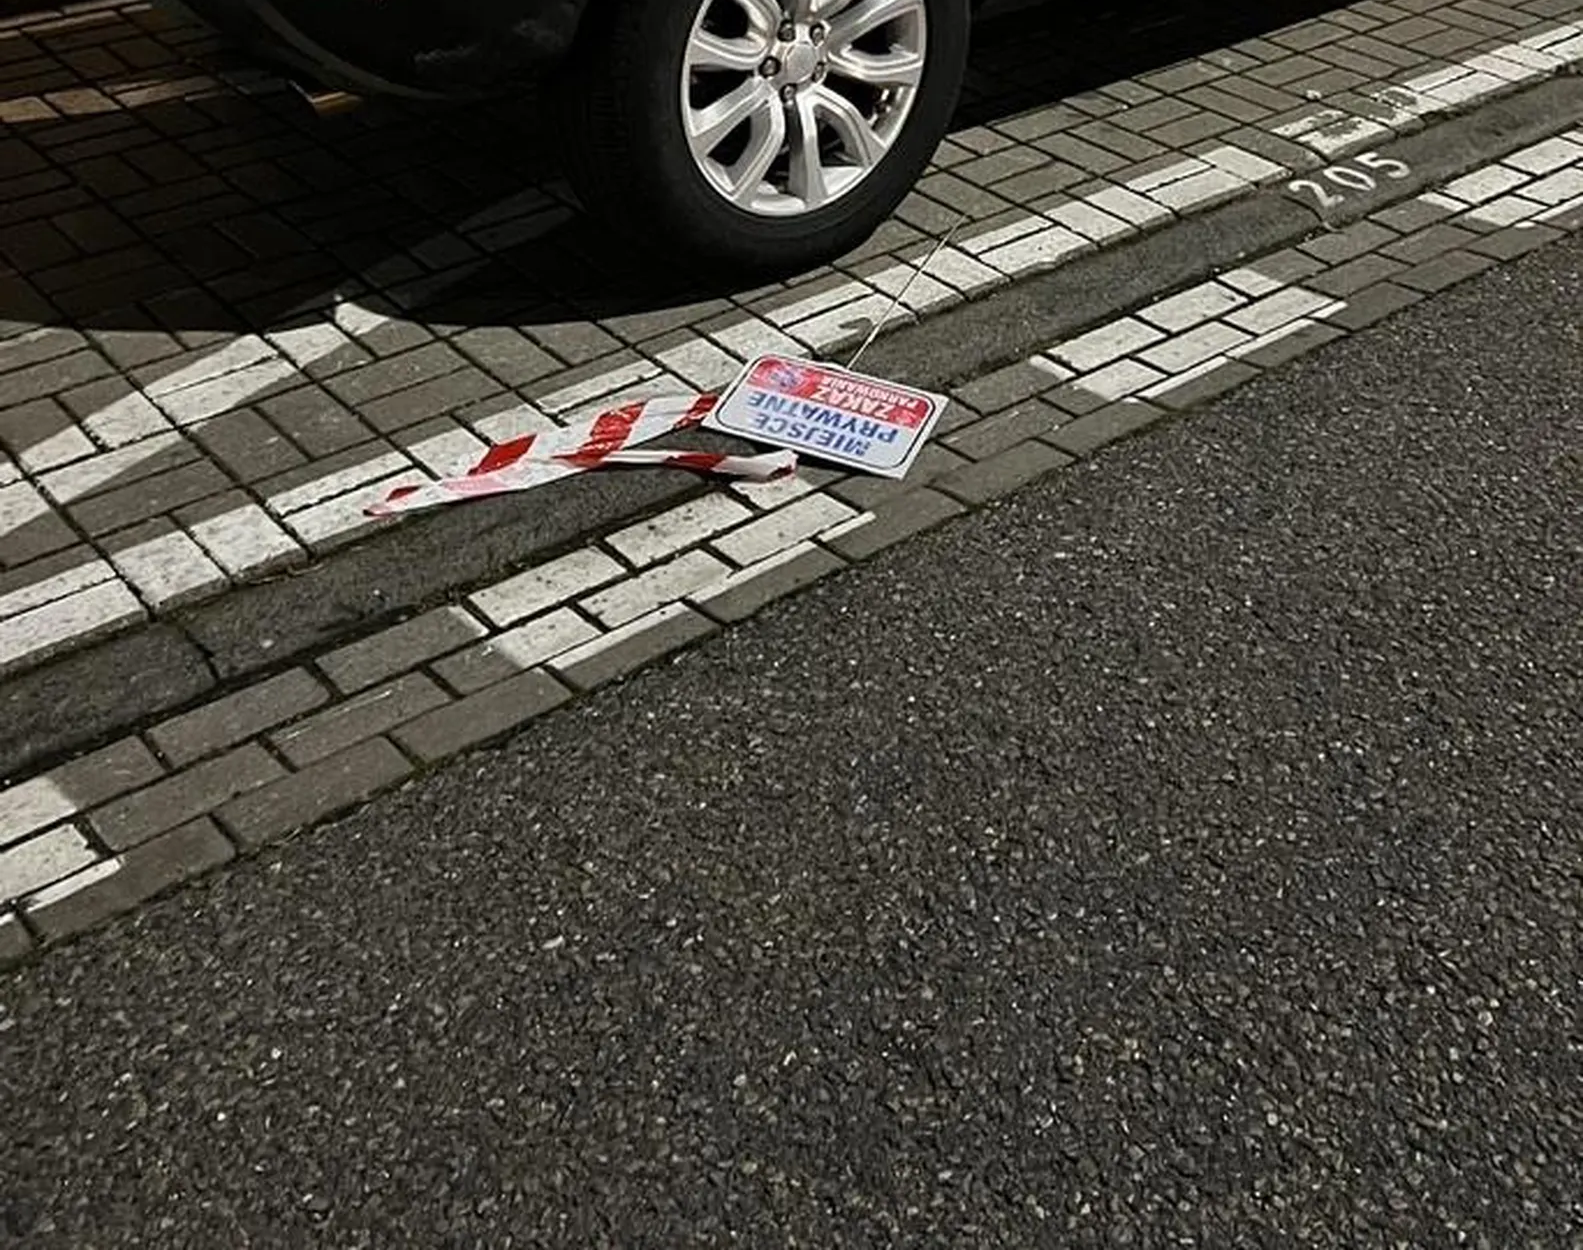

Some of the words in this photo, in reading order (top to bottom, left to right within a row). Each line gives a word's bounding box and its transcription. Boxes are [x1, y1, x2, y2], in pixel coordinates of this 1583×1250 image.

[1289, 152, 1410, 206] 205
[747, 390, 899, 442] PRYWATNE
[809, 385, 891, 419] ZAKAZ
[752, 413, 871, 455] MIEJSCE
